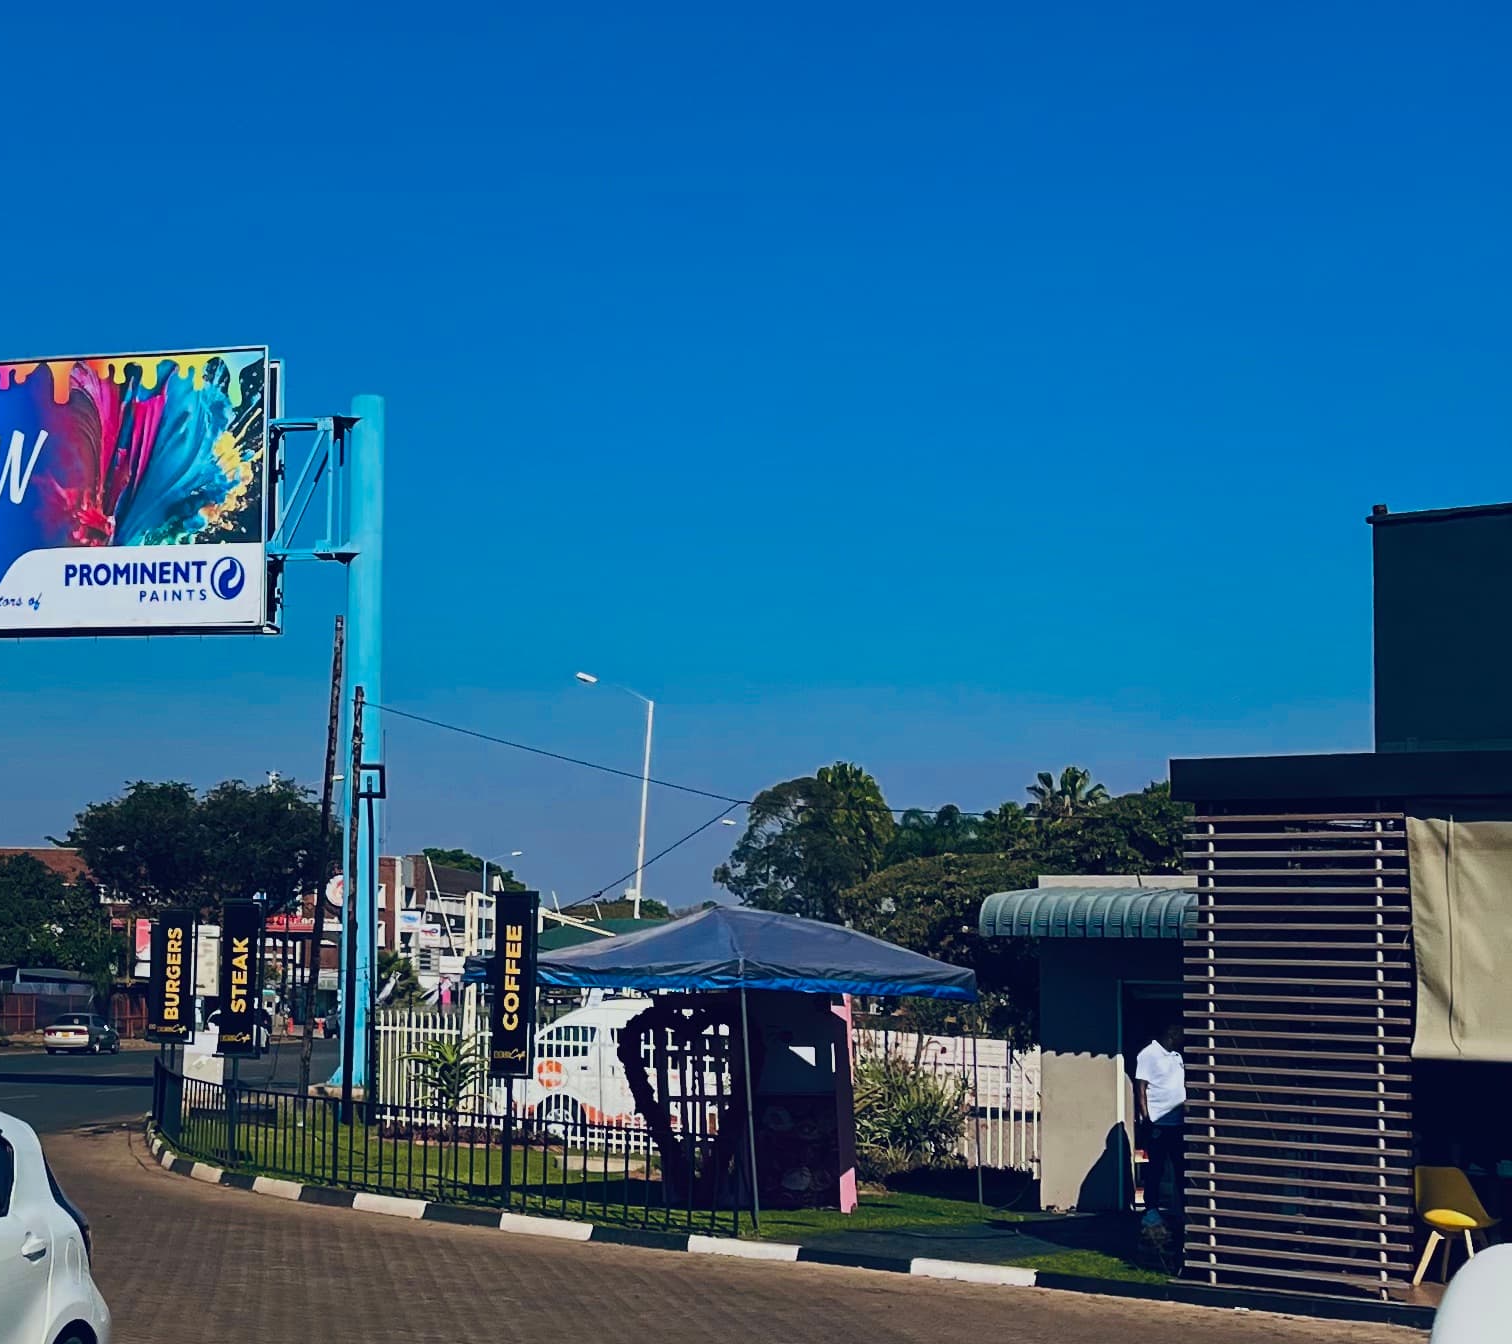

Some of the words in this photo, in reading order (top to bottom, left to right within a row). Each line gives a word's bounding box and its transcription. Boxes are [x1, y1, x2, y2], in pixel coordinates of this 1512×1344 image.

[64, 560, 207, 587] PROMINENT
[139, 588, 207, 603] PAINTS
[28, 592, 42, 611] of
[163, 927, 183, 1021] BURGERS
[230, 937, 249, 1014] STEAK
[502, 924, 523, 1031] COFFEE
